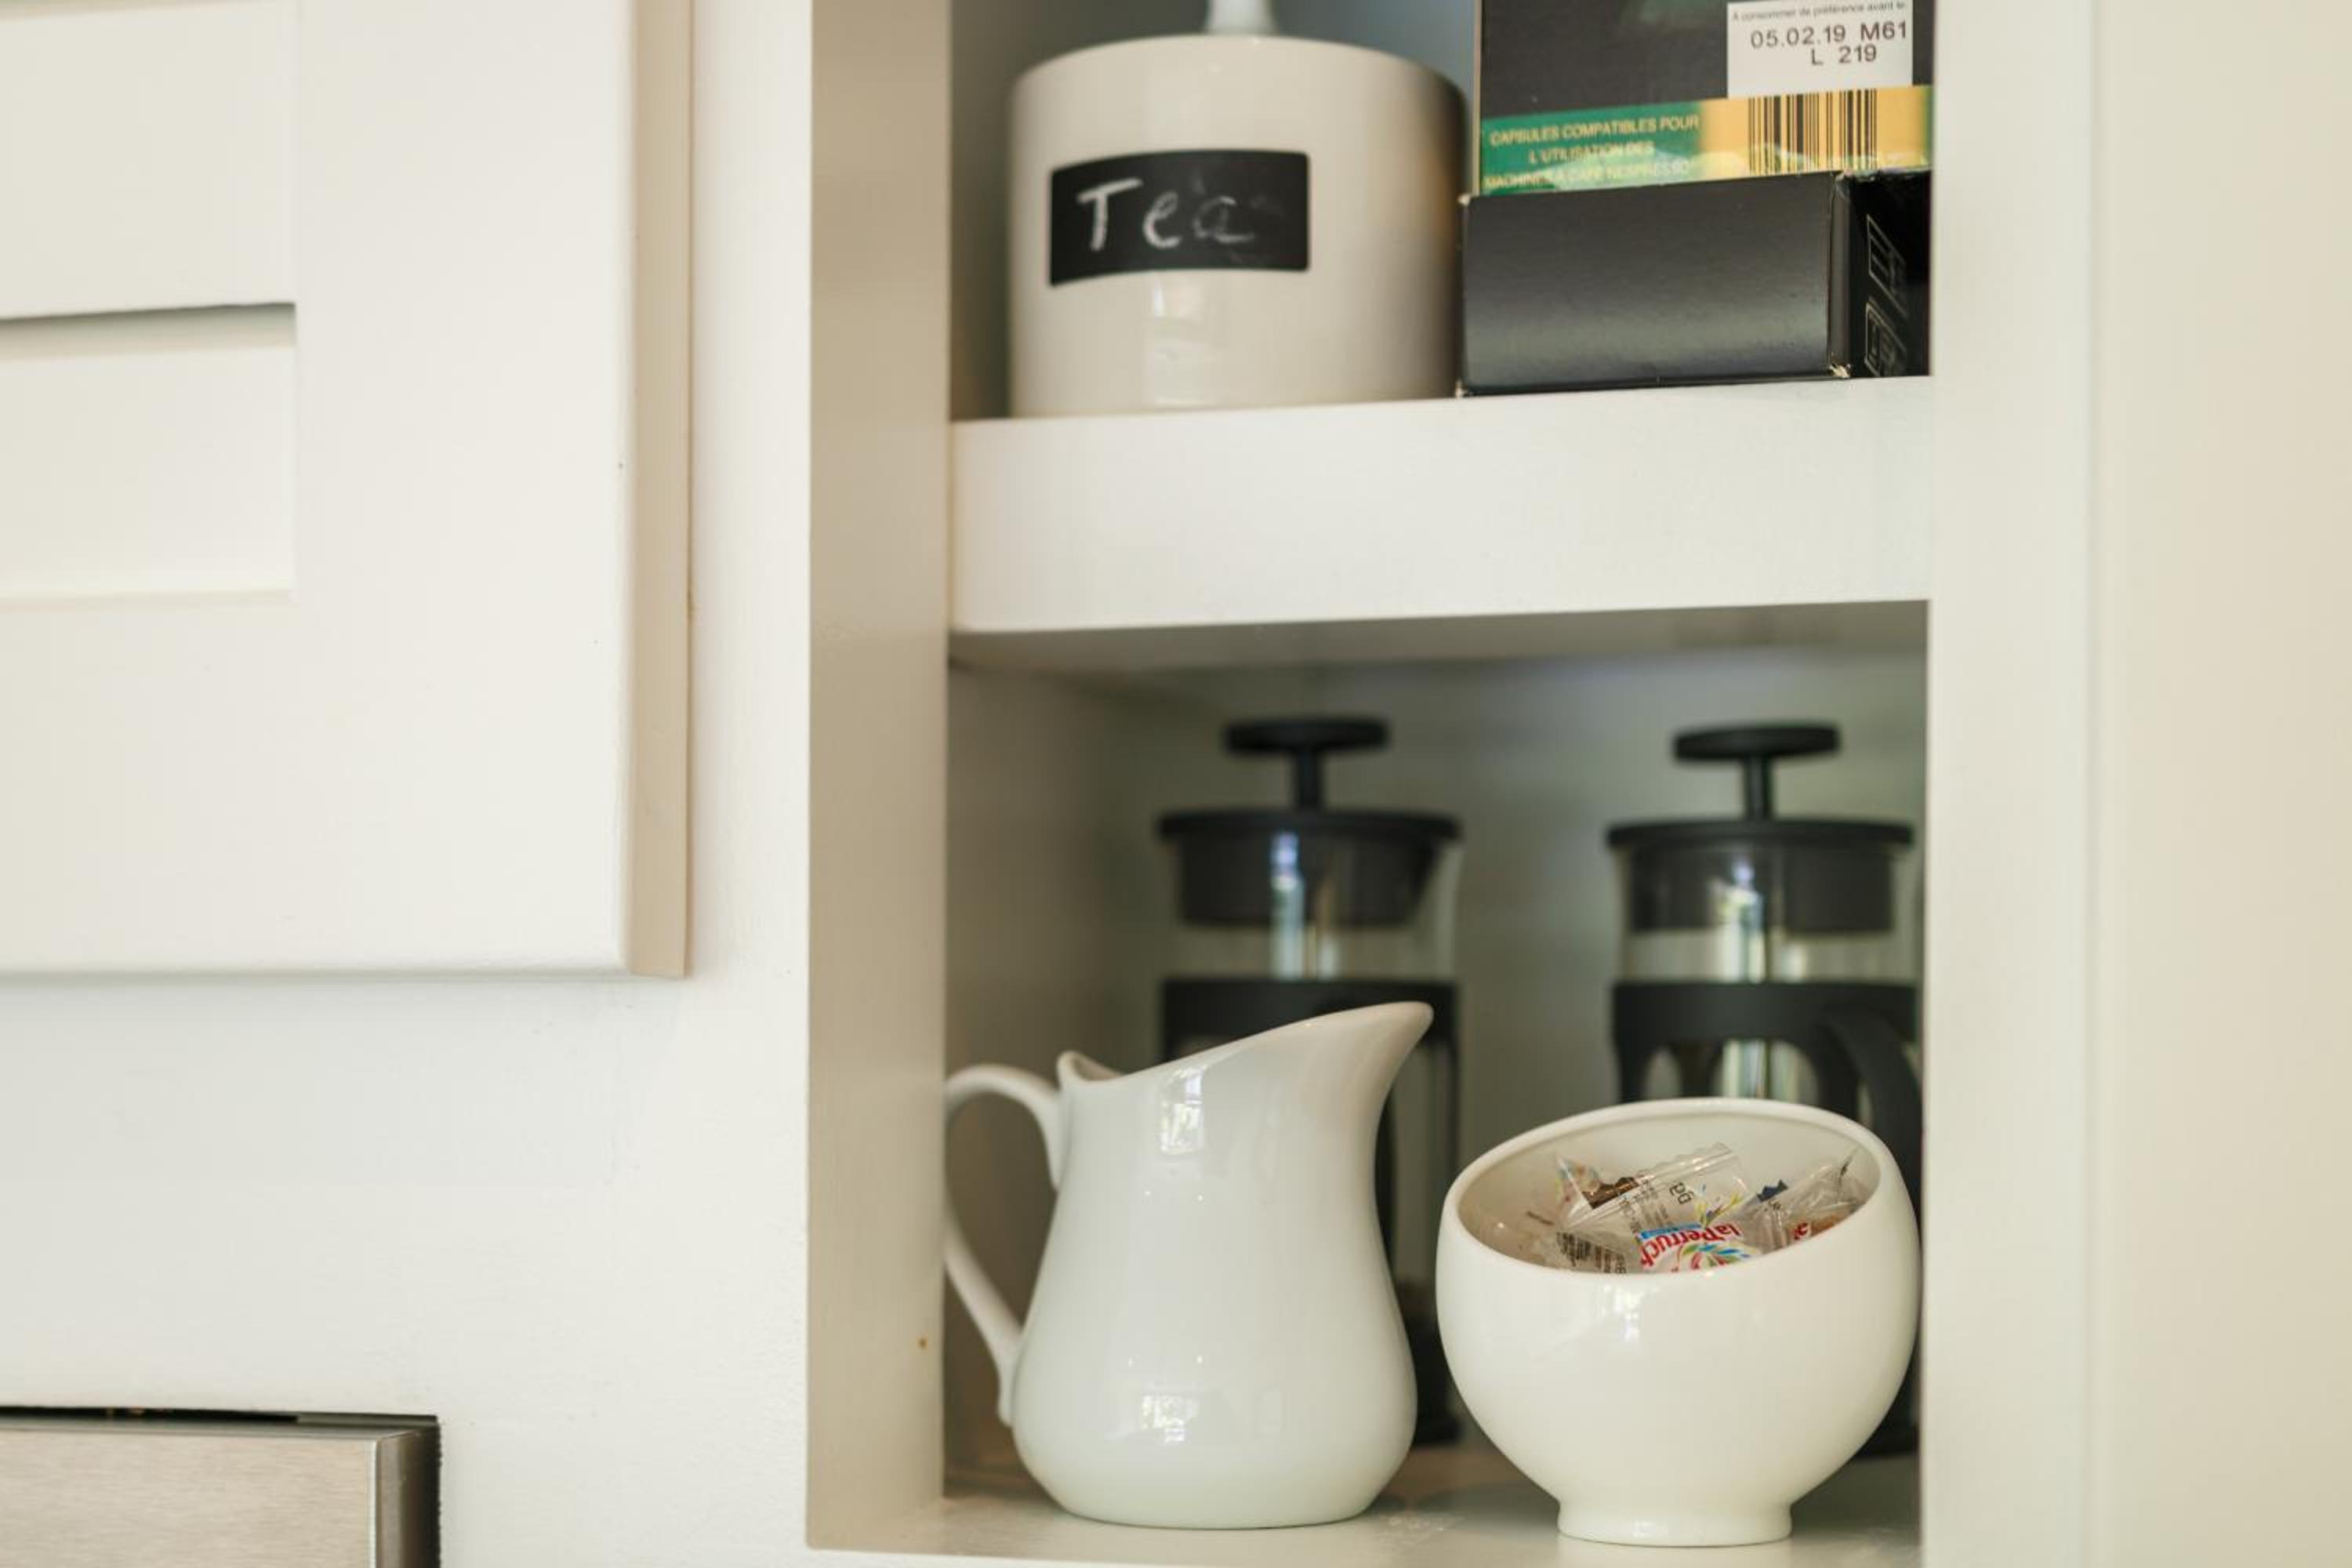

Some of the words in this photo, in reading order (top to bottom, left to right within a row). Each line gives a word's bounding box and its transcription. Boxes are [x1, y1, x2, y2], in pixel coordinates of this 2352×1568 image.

[1750, 24, 1846, 49] 05.02.19
[1860, 20, 1907, 41] M61
[1811, 48, 1823, 65] L
[1838, 45, 1877, 64] 219
[1490, 125, 1559, 146] CAPSULES
[1562, 118, 1656, 140] COMPATIBLES
[1659, 115, 1699, 131] POUR
[1076, 176, 1256, 251] Tea
